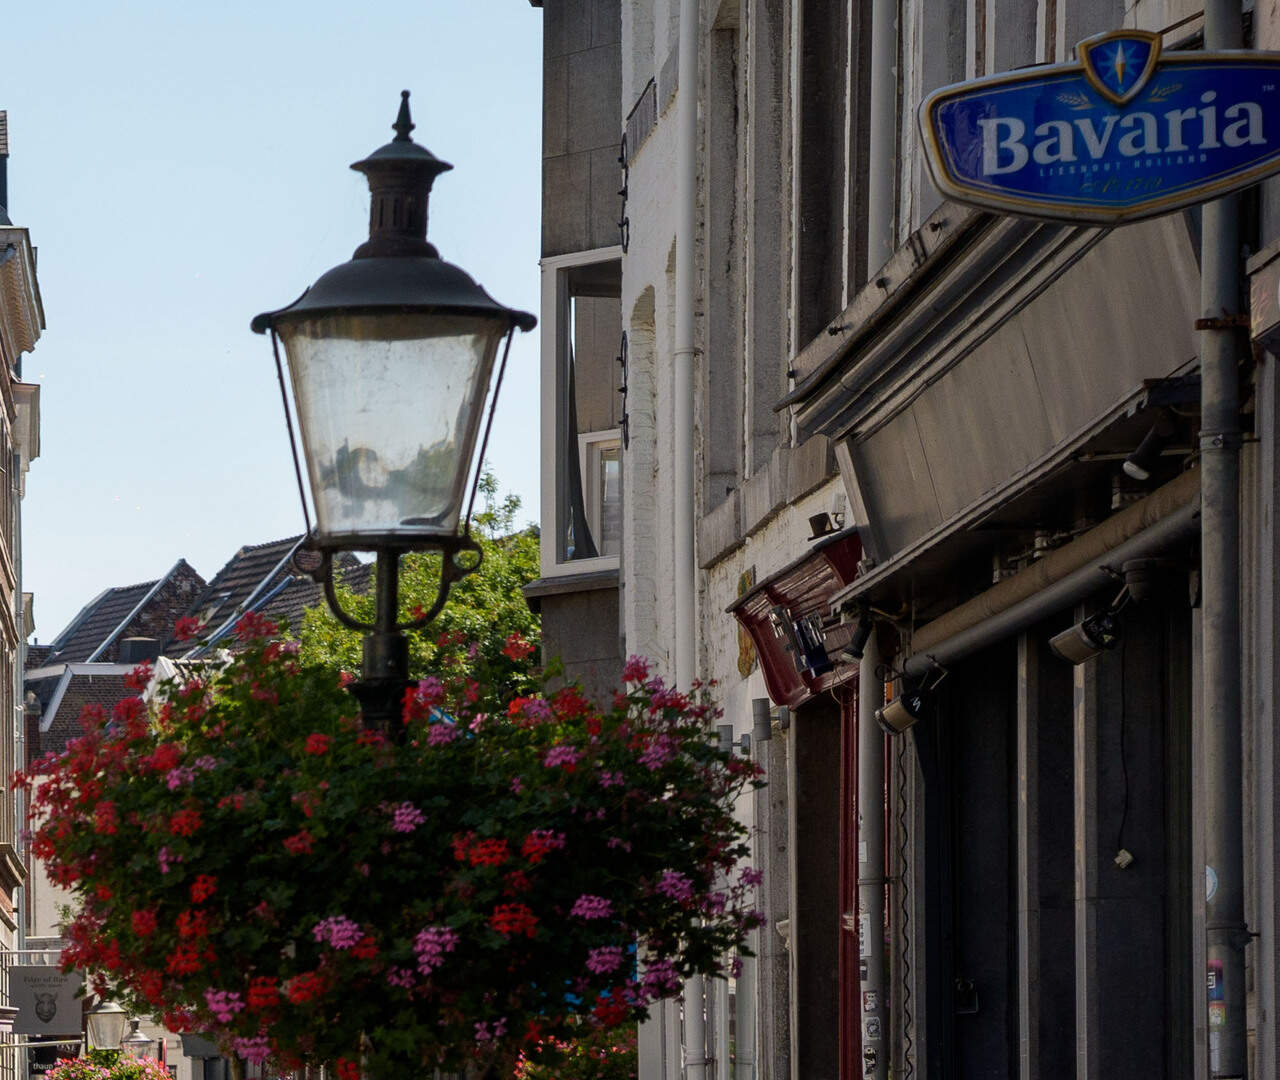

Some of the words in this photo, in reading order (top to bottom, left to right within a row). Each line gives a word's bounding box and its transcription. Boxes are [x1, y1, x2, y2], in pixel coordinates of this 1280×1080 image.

[977, 91, 1268, 177] Bavaria
[1040, 162, 1121, 177] LIESHOUT
[1134, 154, 1208, 170] HOLLAND
